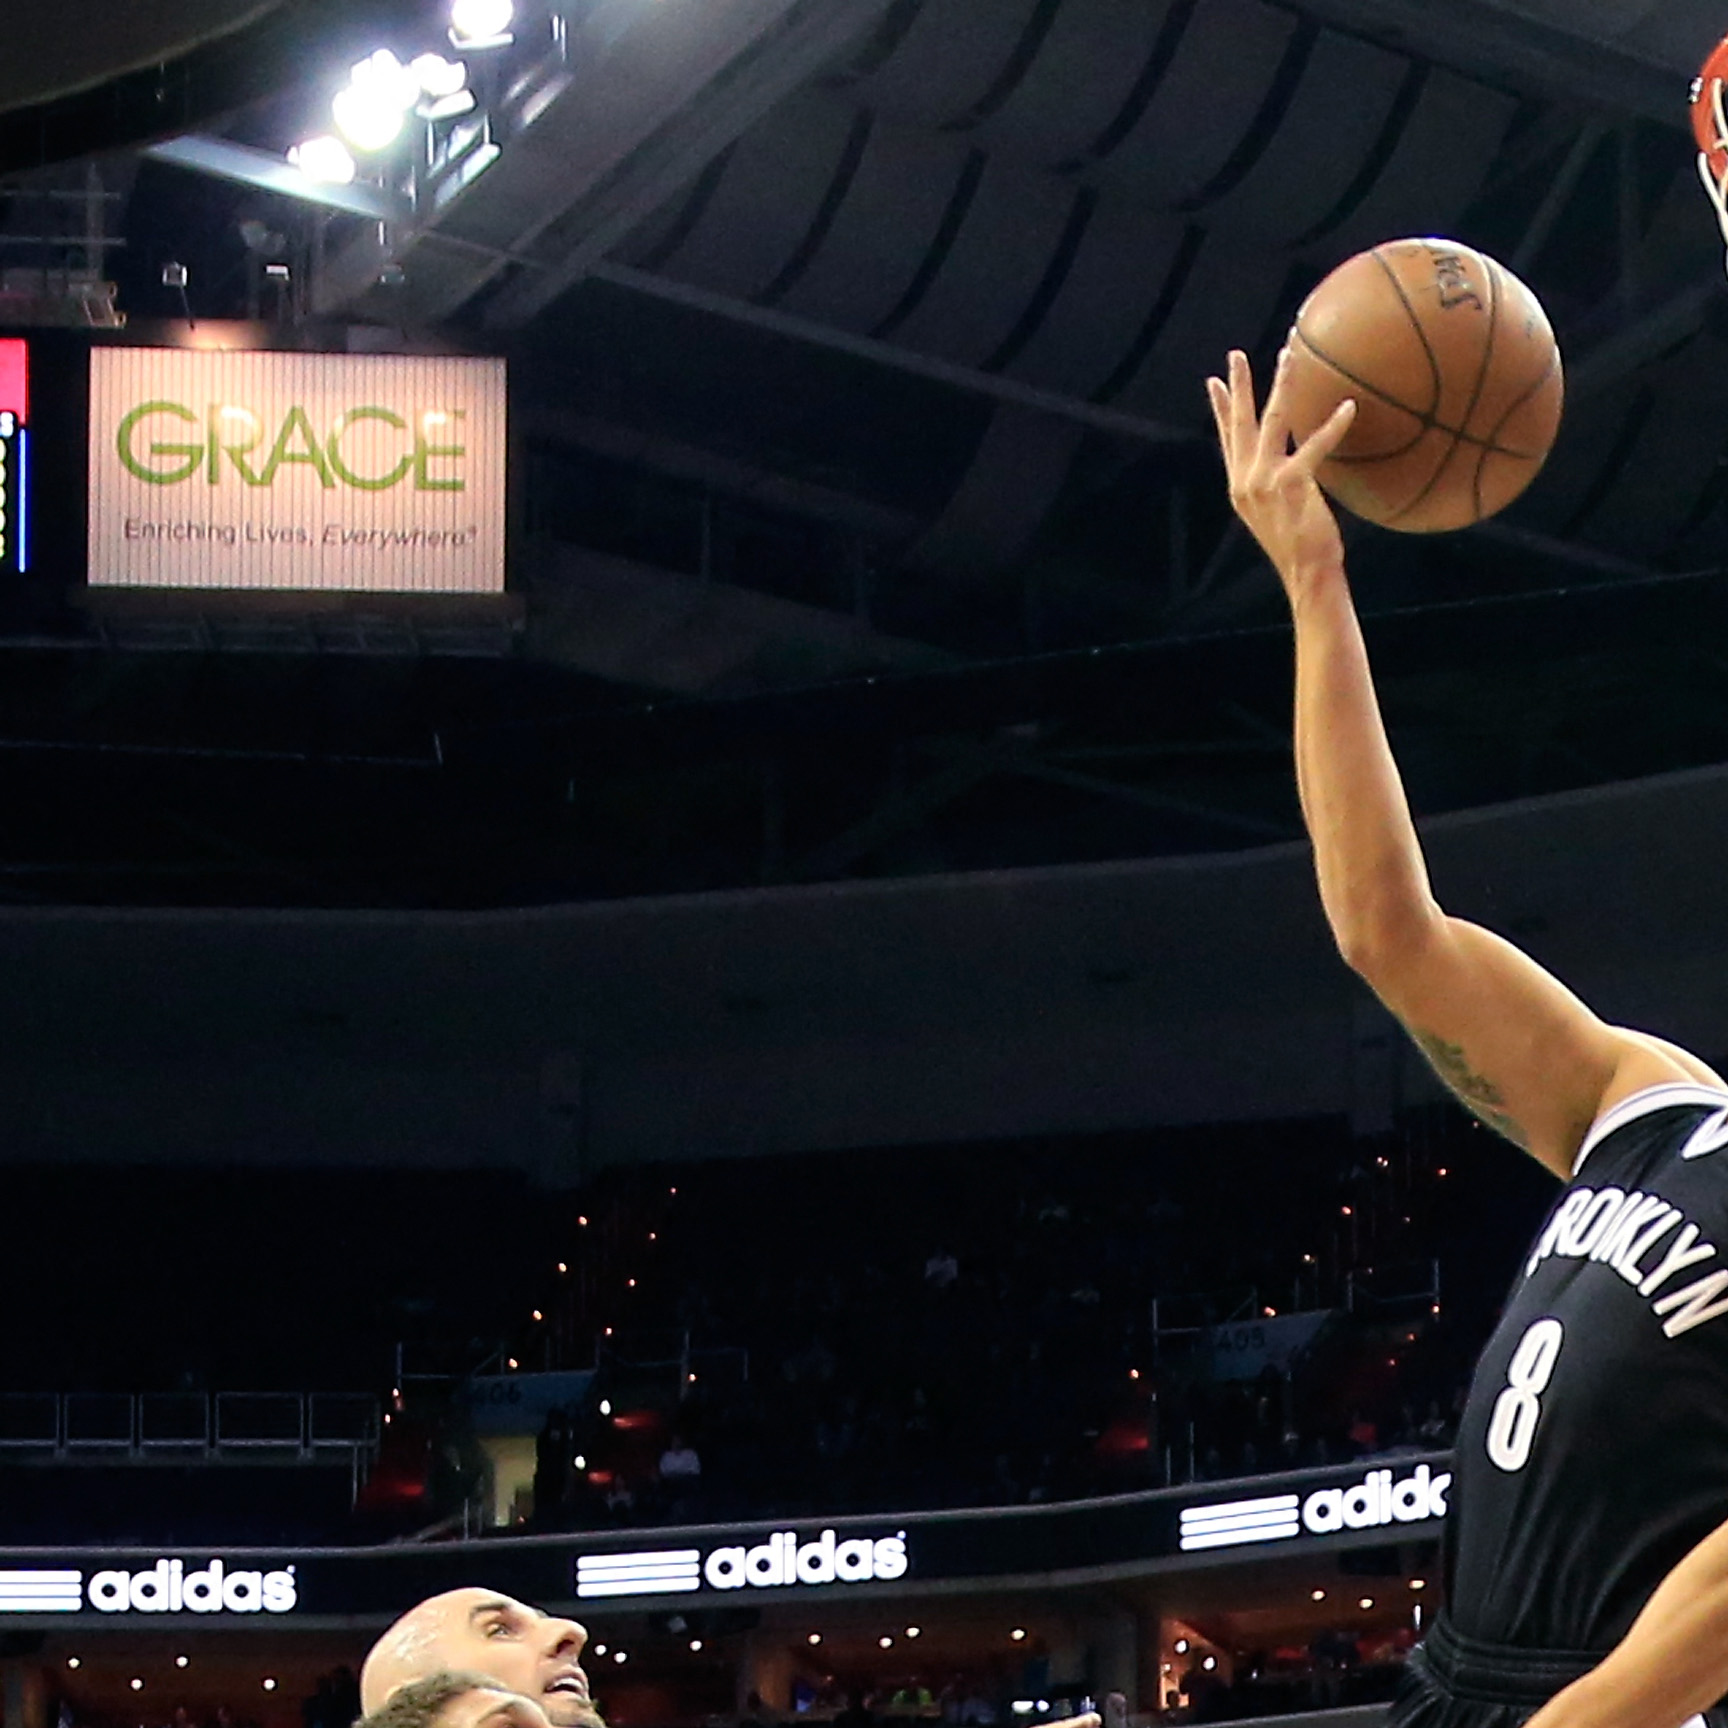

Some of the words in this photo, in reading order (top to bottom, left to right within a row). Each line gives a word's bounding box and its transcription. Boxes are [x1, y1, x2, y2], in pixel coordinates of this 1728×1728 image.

[117, 401, 466, 491] GRACE
[124, 518, 236, 546] Enriching
[1487, 1318, 1564, 1472] 8
[89, 1559, 296, 1613] adidas
[705, 1529, 907, 1591] adidas
